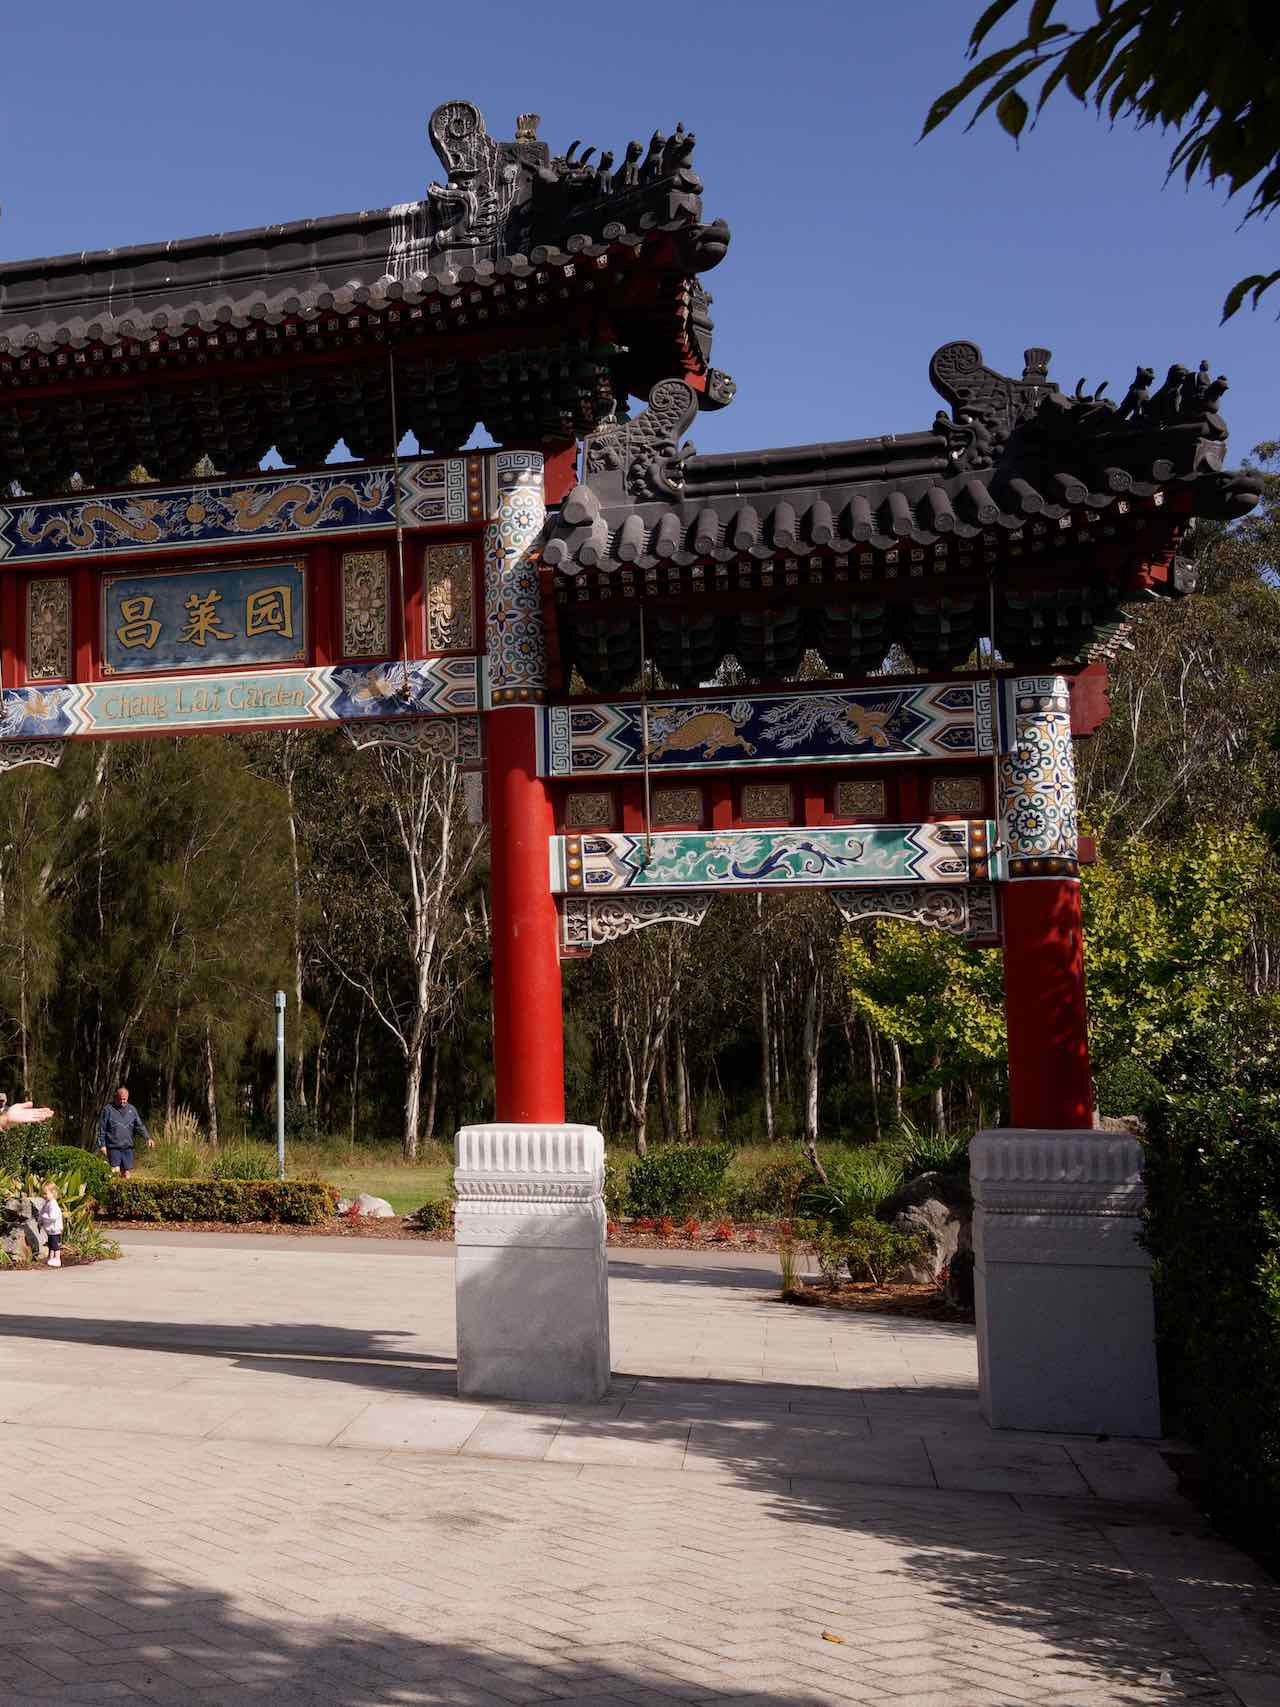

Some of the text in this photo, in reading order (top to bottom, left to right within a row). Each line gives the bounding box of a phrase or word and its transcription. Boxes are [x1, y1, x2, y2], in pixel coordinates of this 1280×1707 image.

[116, 585, 293, 649] 昌莱园
[103, 683, 305, 720] Chang Lai Garden
